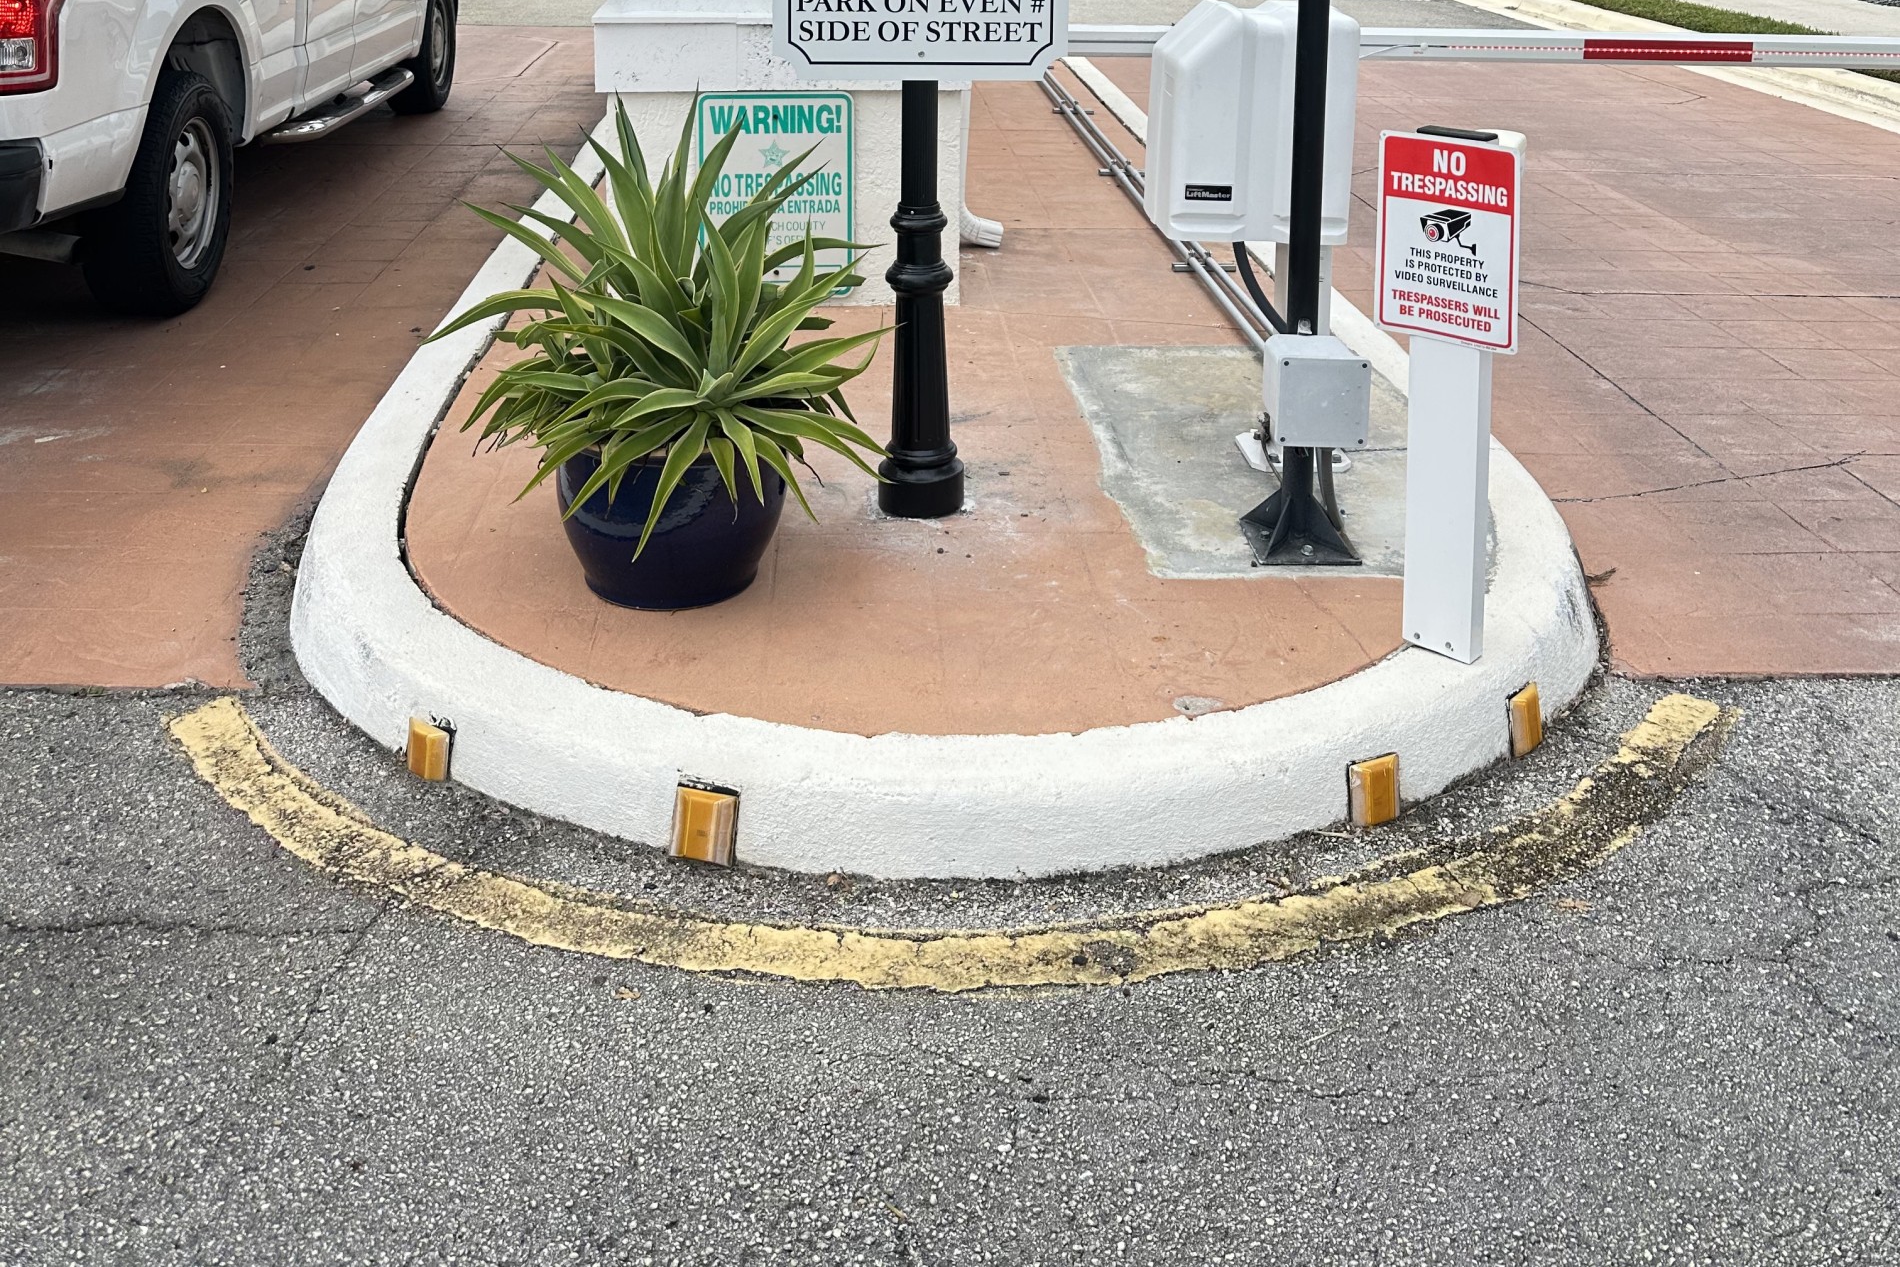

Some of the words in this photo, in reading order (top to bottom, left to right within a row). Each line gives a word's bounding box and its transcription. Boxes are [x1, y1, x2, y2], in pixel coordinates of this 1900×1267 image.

[799, 21, 870, 42] SIDE
[878, 21, 919, 42] OF
[926, 21, 1043, 43] STREET
[709, 104, 842, 134] WARNING!
[1433, 149, 1466, 176] NO
[1186, 190, 1231, 198] LiftMaster
[1391, 171, 1508, 207] TRESPASSING
[788, 199, 841, 214] ENTRADA
[1405, 259, 1415, 268] IS
[1418, 262, 1472, 281] PROTECTED
[1475, 273, 1489, 283] BY
[1410, 247, 1432, 260] THIS
[1434, 251, 1485, 269] PROPERTY
[1394, 269, 1424, 283] VIDEO
[1426, 276, 1499, 298] SURVEILLANCE
[1391, 289, 1469, 313] TRESPASSERS
[1472, 304, 1501, 320] WILL
[1399, 304, 1414, 316] BE
[1418, 308, 1492, 332] PROSECUTED
